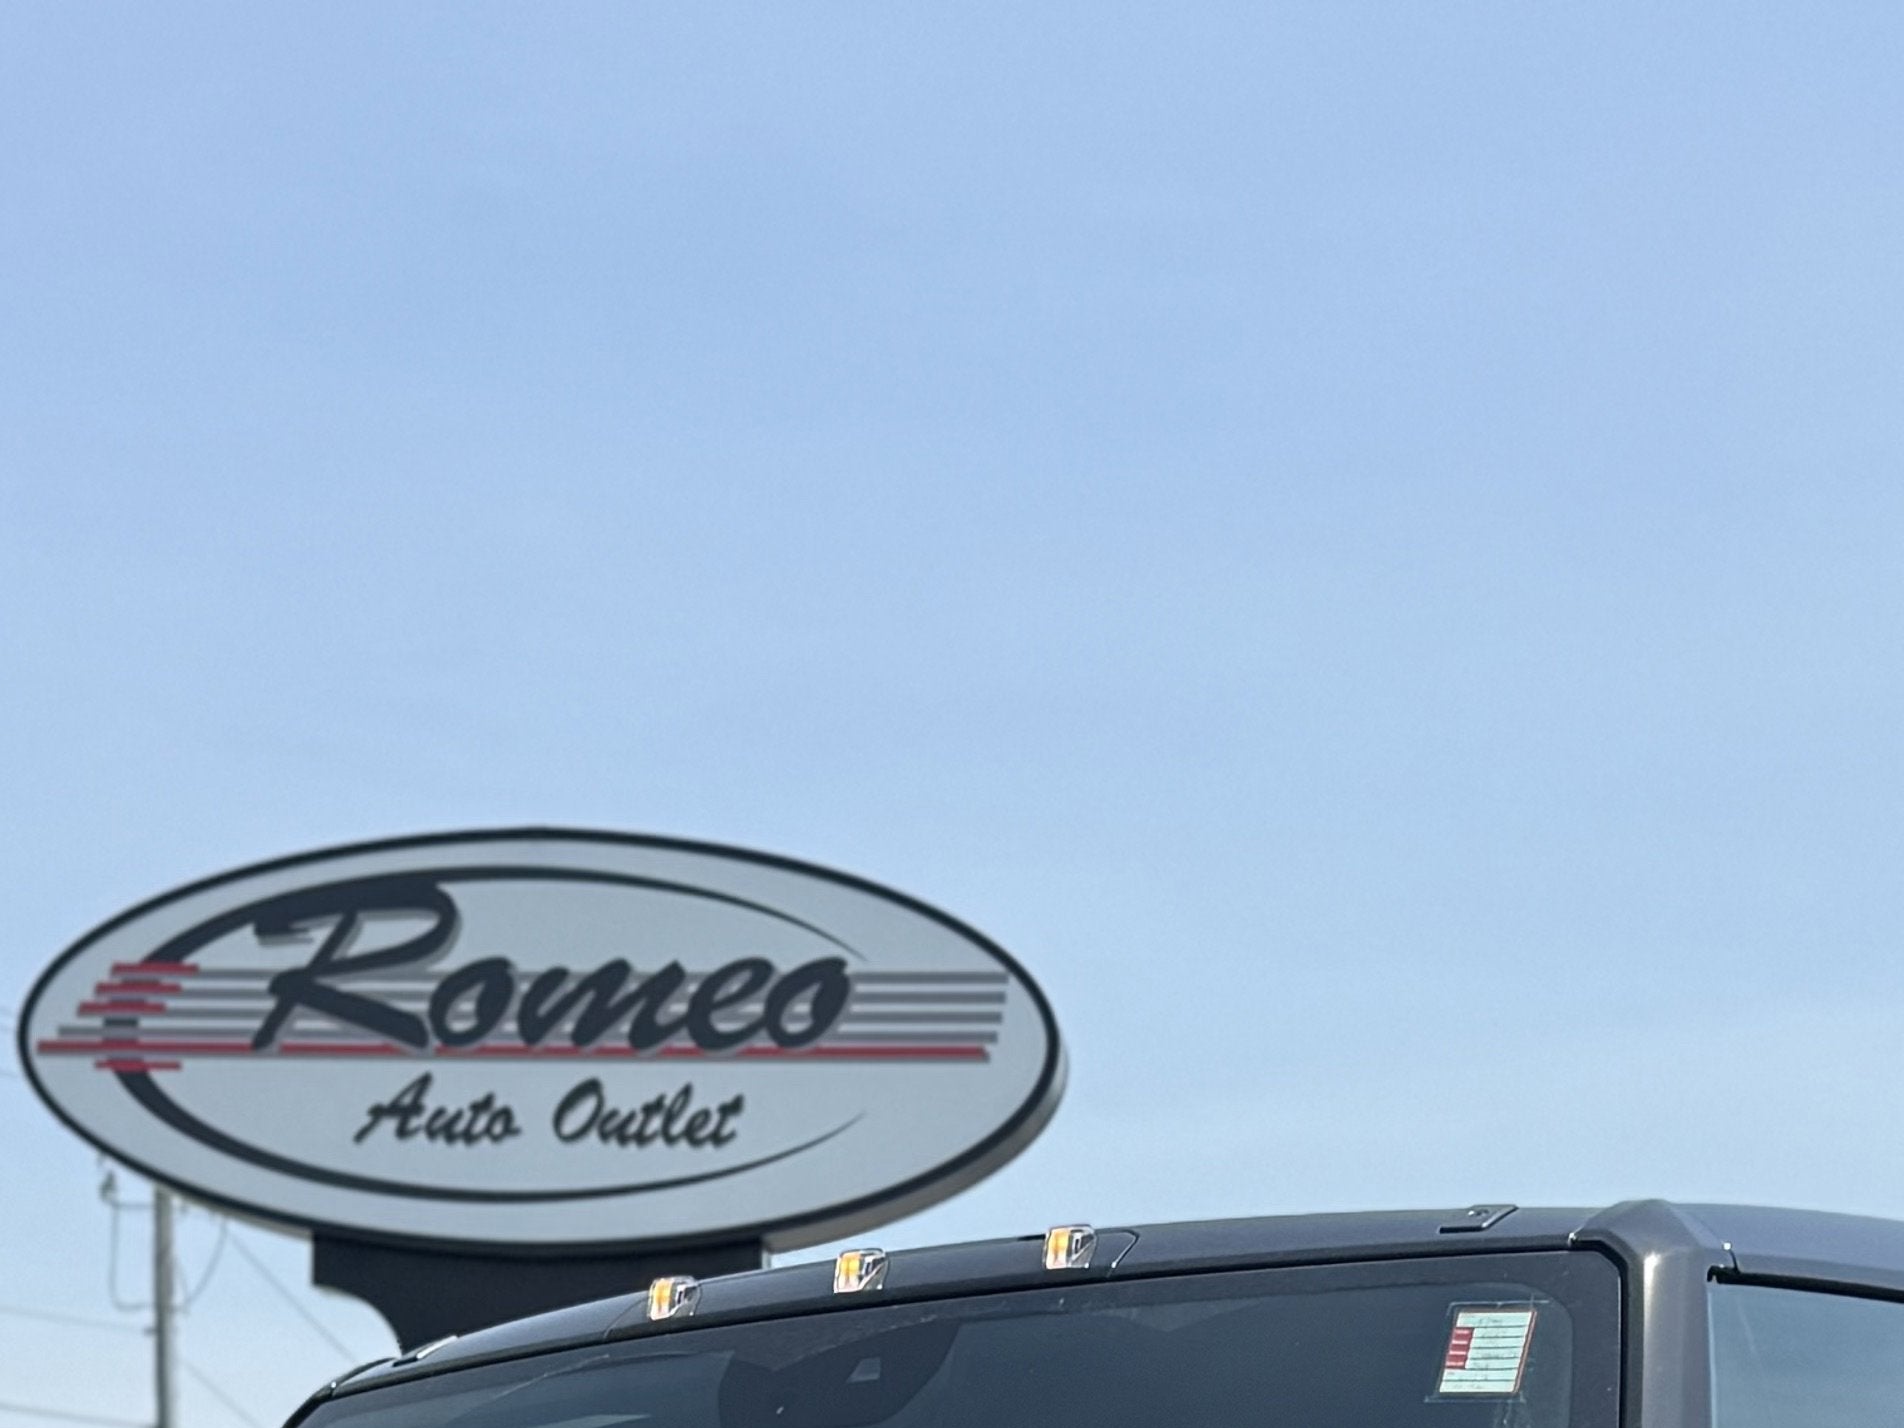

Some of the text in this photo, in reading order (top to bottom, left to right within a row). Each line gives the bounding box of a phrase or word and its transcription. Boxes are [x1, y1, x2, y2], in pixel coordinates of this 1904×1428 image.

[251, 880, 852, 1054] Romeo
[354, 1073, 746, 1149] Auto Outlet
